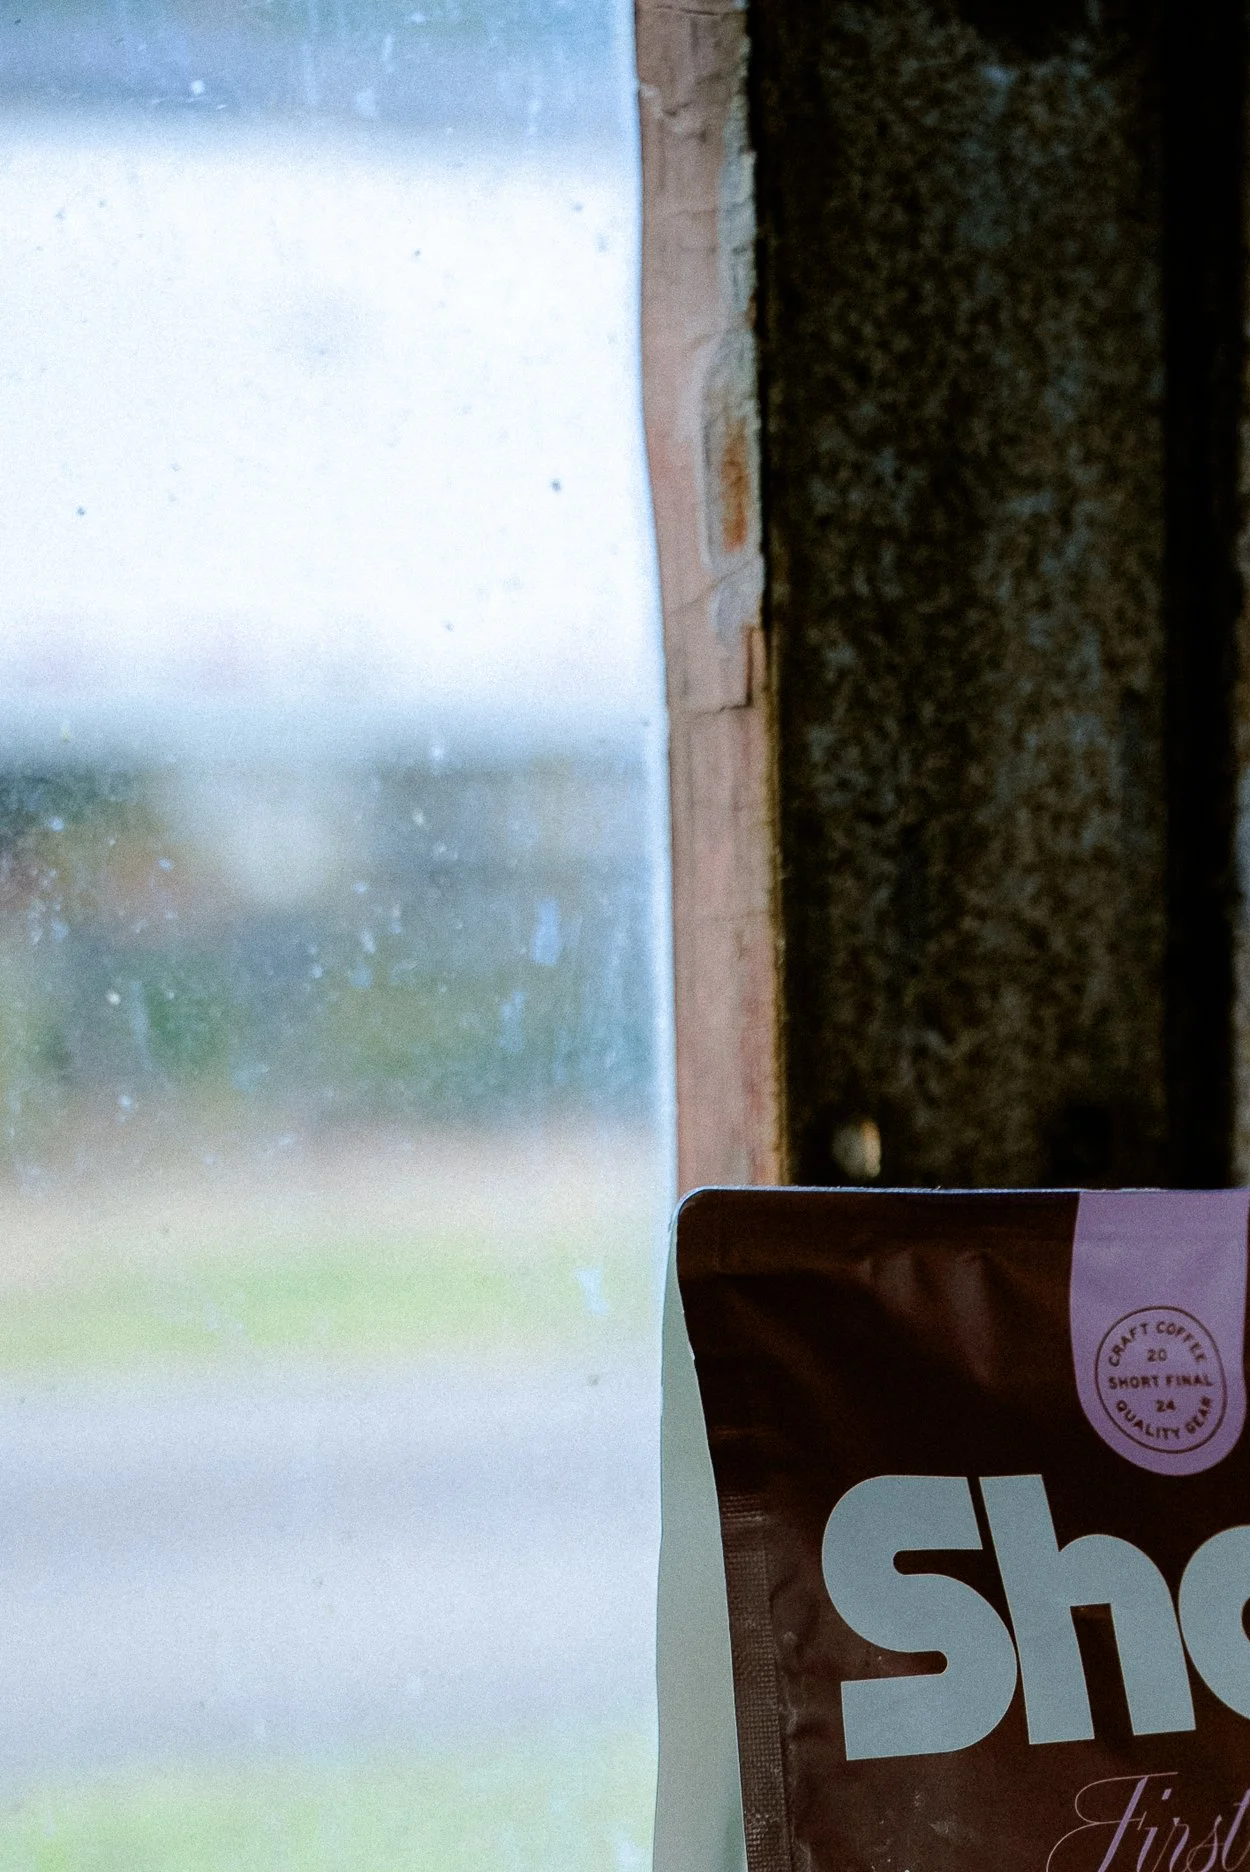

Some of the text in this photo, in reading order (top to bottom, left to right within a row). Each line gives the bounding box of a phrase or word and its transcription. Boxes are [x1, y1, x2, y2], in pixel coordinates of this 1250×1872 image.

[1108, 1322, 1149, 1367] CRAFT
[1147, 1349, 1168, 1363] 20
[1108, 1373, 1214, 1389] SHORT FINAL
[1156, 1399, 1176, 1413] 24
[1116, 1400, 1180, 1440] QUALITY
